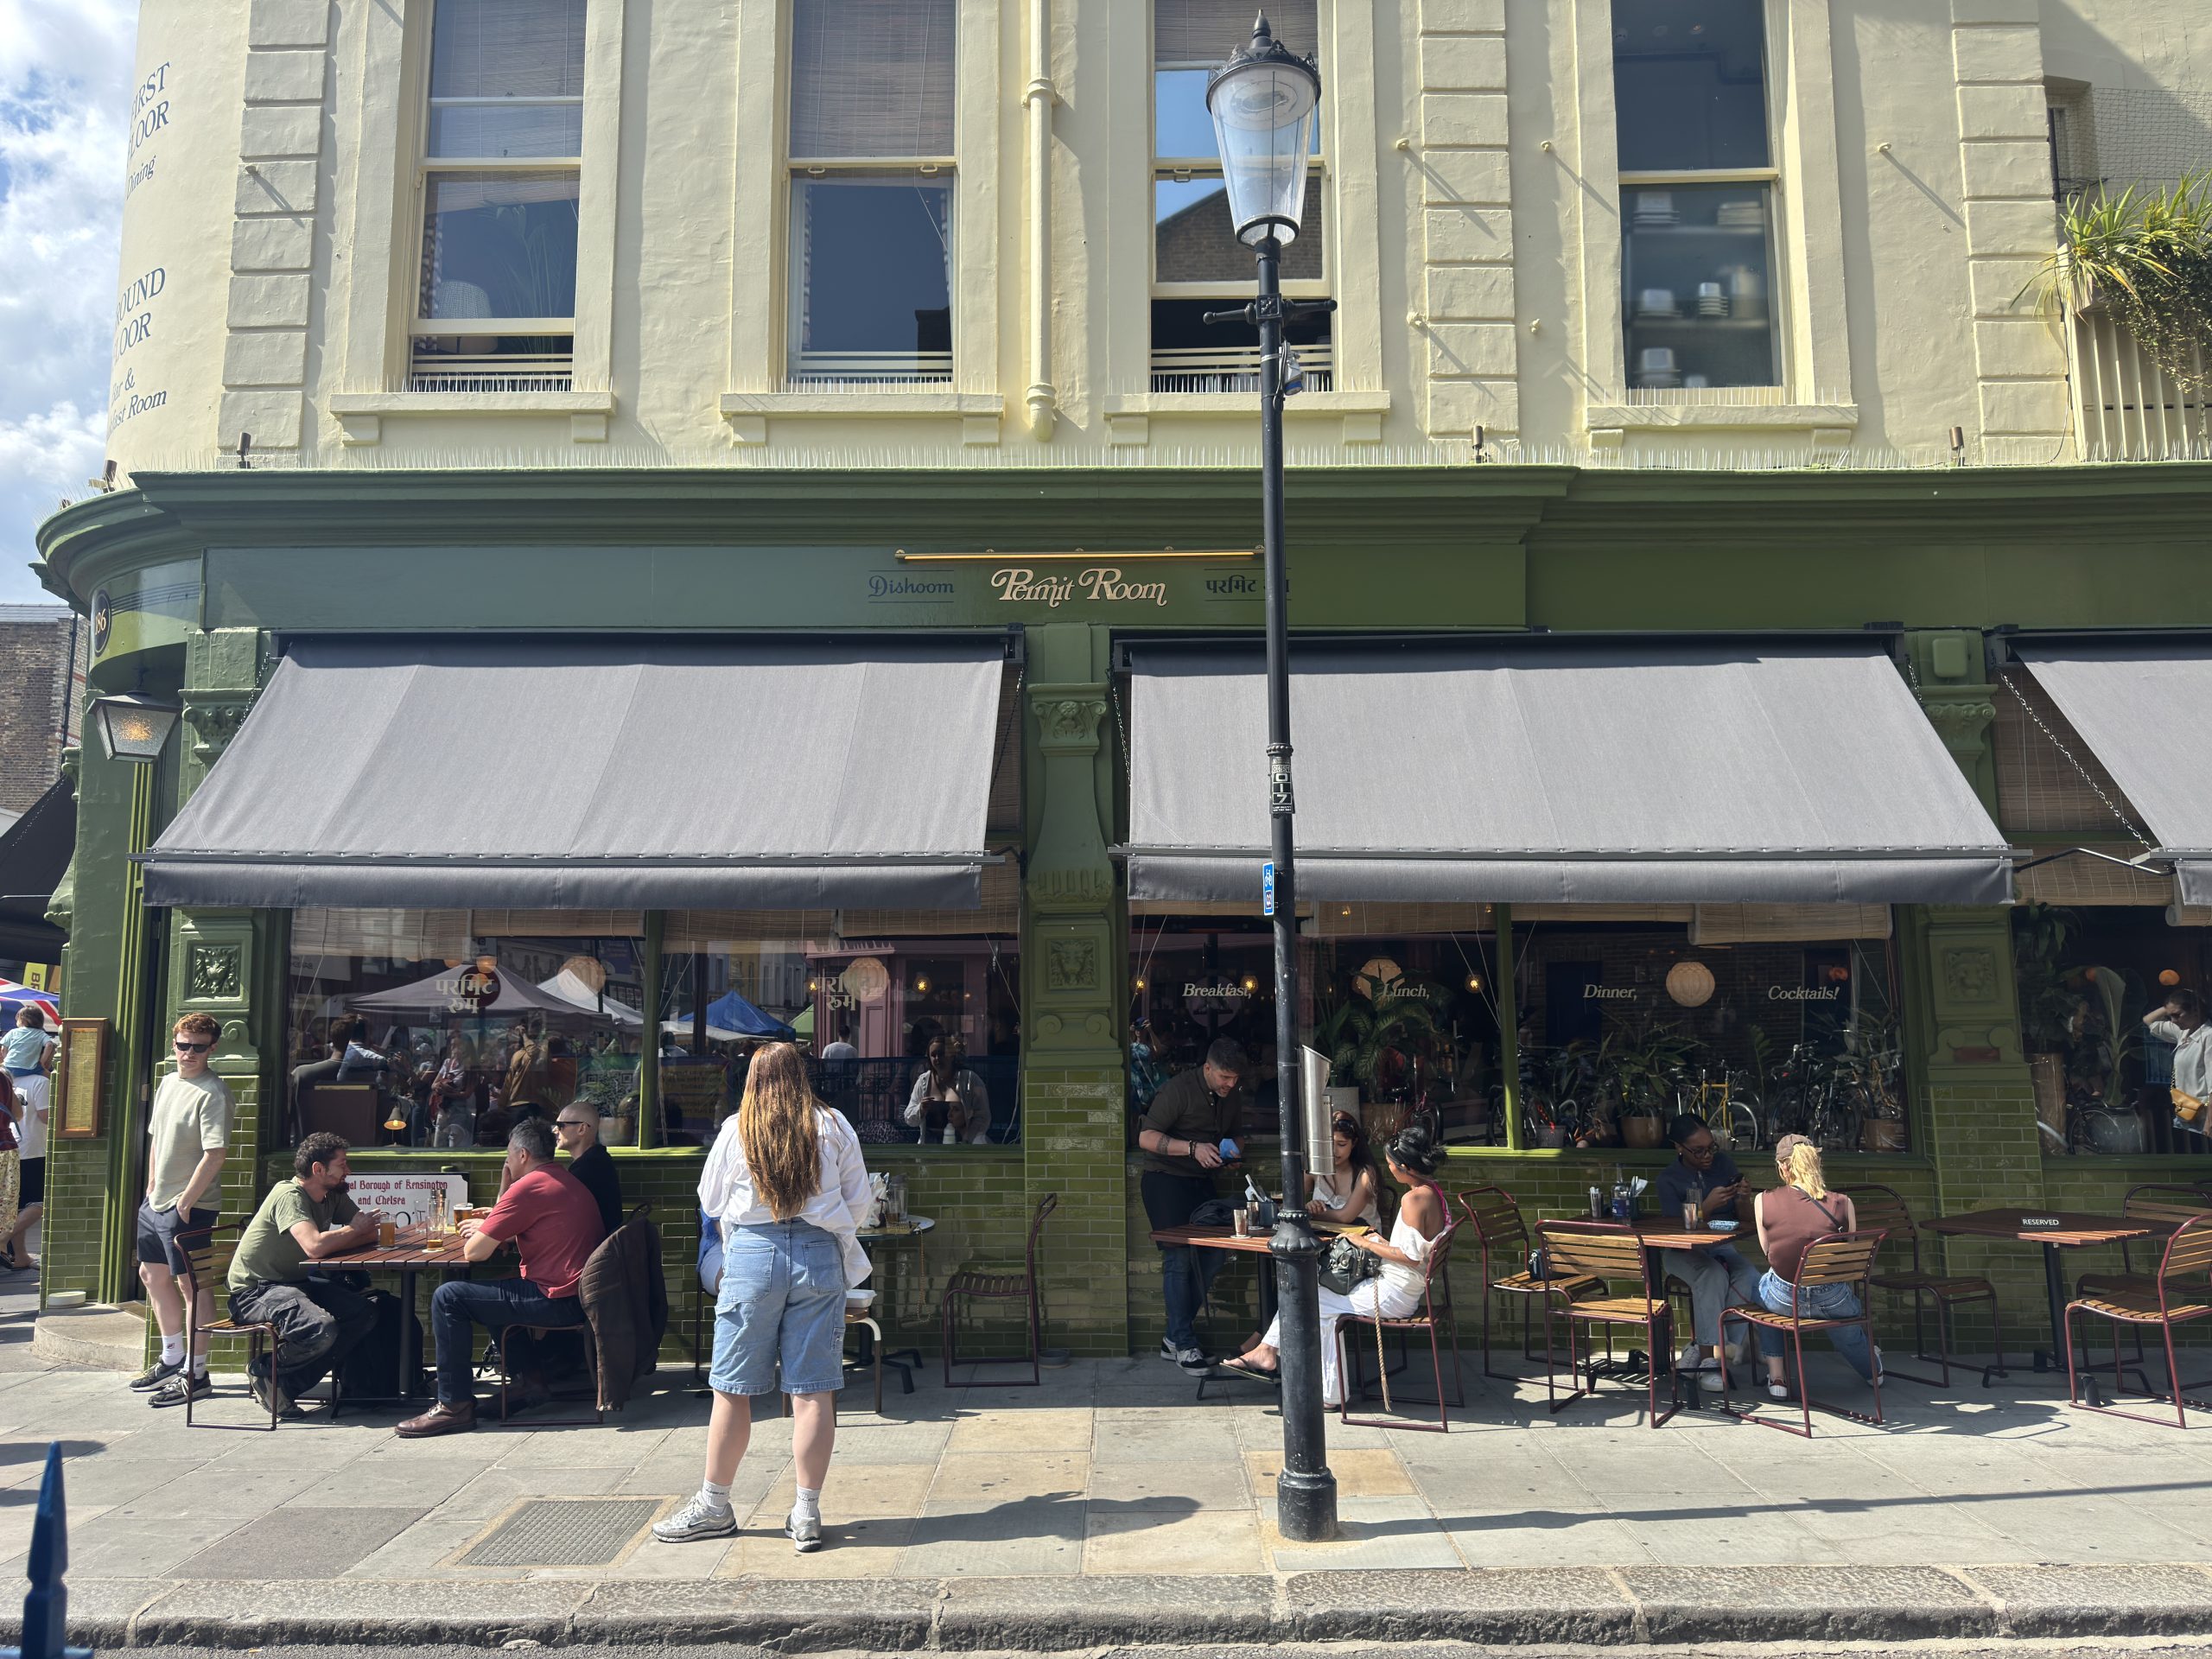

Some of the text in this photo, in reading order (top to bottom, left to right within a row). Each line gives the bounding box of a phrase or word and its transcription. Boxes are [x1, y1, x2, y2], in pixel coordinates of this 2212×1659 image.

[126, 155, 156, 200] Dining
[124, 367, 136, 391] &
[127, 391, 167, 419] Room
[868, 575, 954, 597] Dishoom
[991, 568, 1166, 607] Permit Room
[1205, 575, 1258, 594] परमिट
[95, 608, 106, 636] 186
[1182, 982, 1252, 1000] Breakfast,
[1382, 983, 1430, 1000] Lunch,
[1583, 984, 1637, 1001] Dinner,
[1768, 985, 1840, 1001] Cocktails!
[359, 1179, 391, 1192] Borough
[395, 1179, 403, 1191] of
[358, 1195, 405, 1205] and Chelsea
